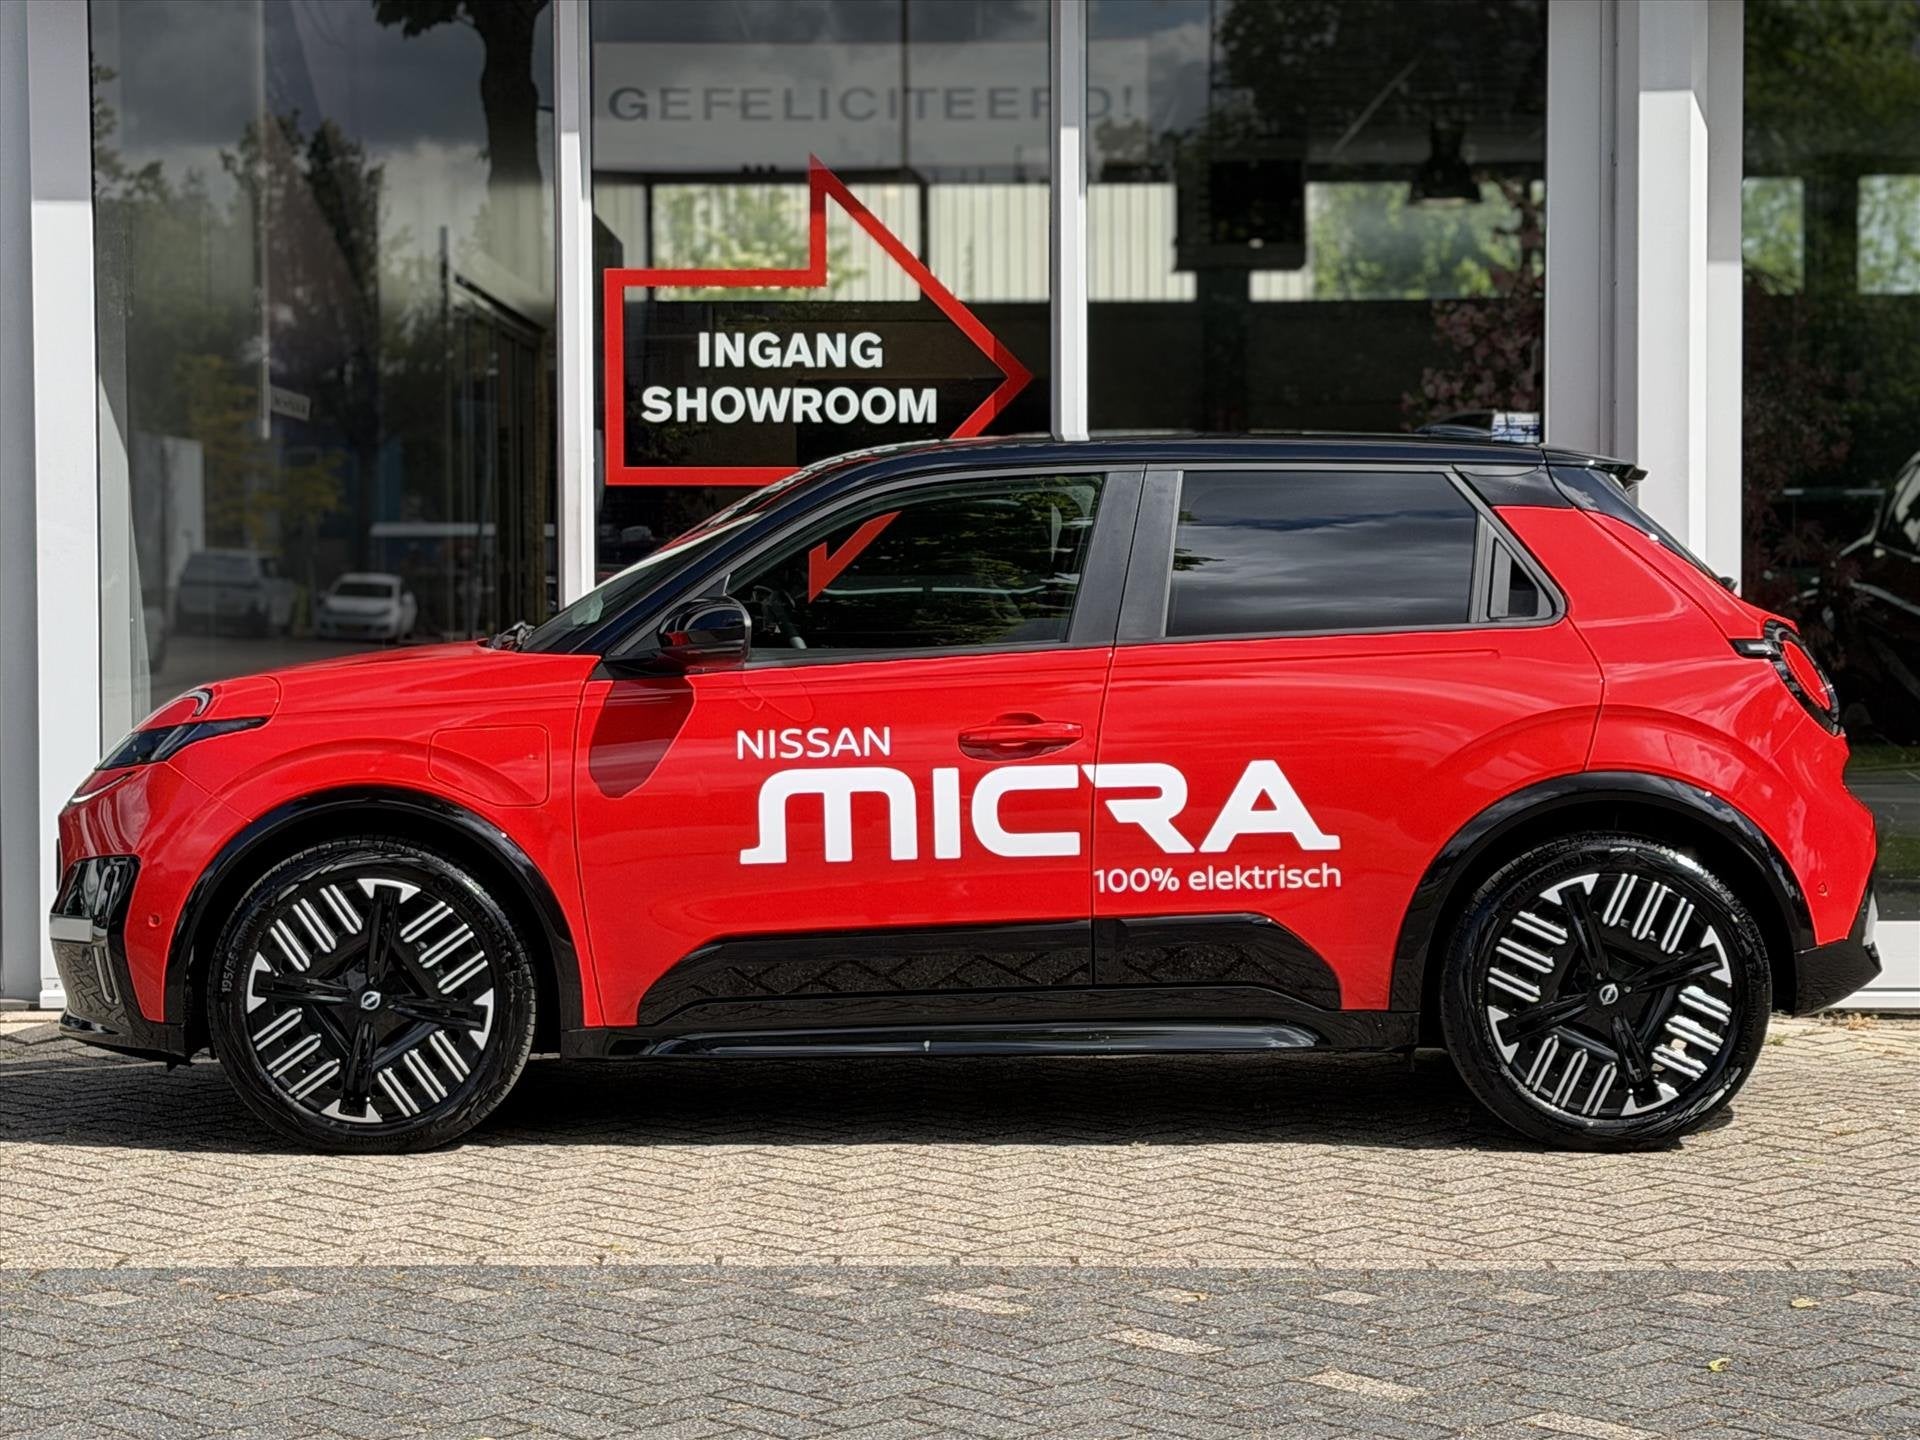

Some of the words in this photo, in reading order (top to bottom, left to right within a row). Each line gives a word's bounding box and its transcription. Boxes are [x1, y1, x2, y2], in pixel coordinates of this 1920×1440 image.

[698, 331, 883, 369] INGANG
[641, 385, 937, 424] SHOWROOM
[736, 726, 891, 761] NISSAN
[740, 759, 1340, 866] MICRA
[1094, 867, 1180, 893] 100%
[1188, 862, 1341, 891] elektrisch
